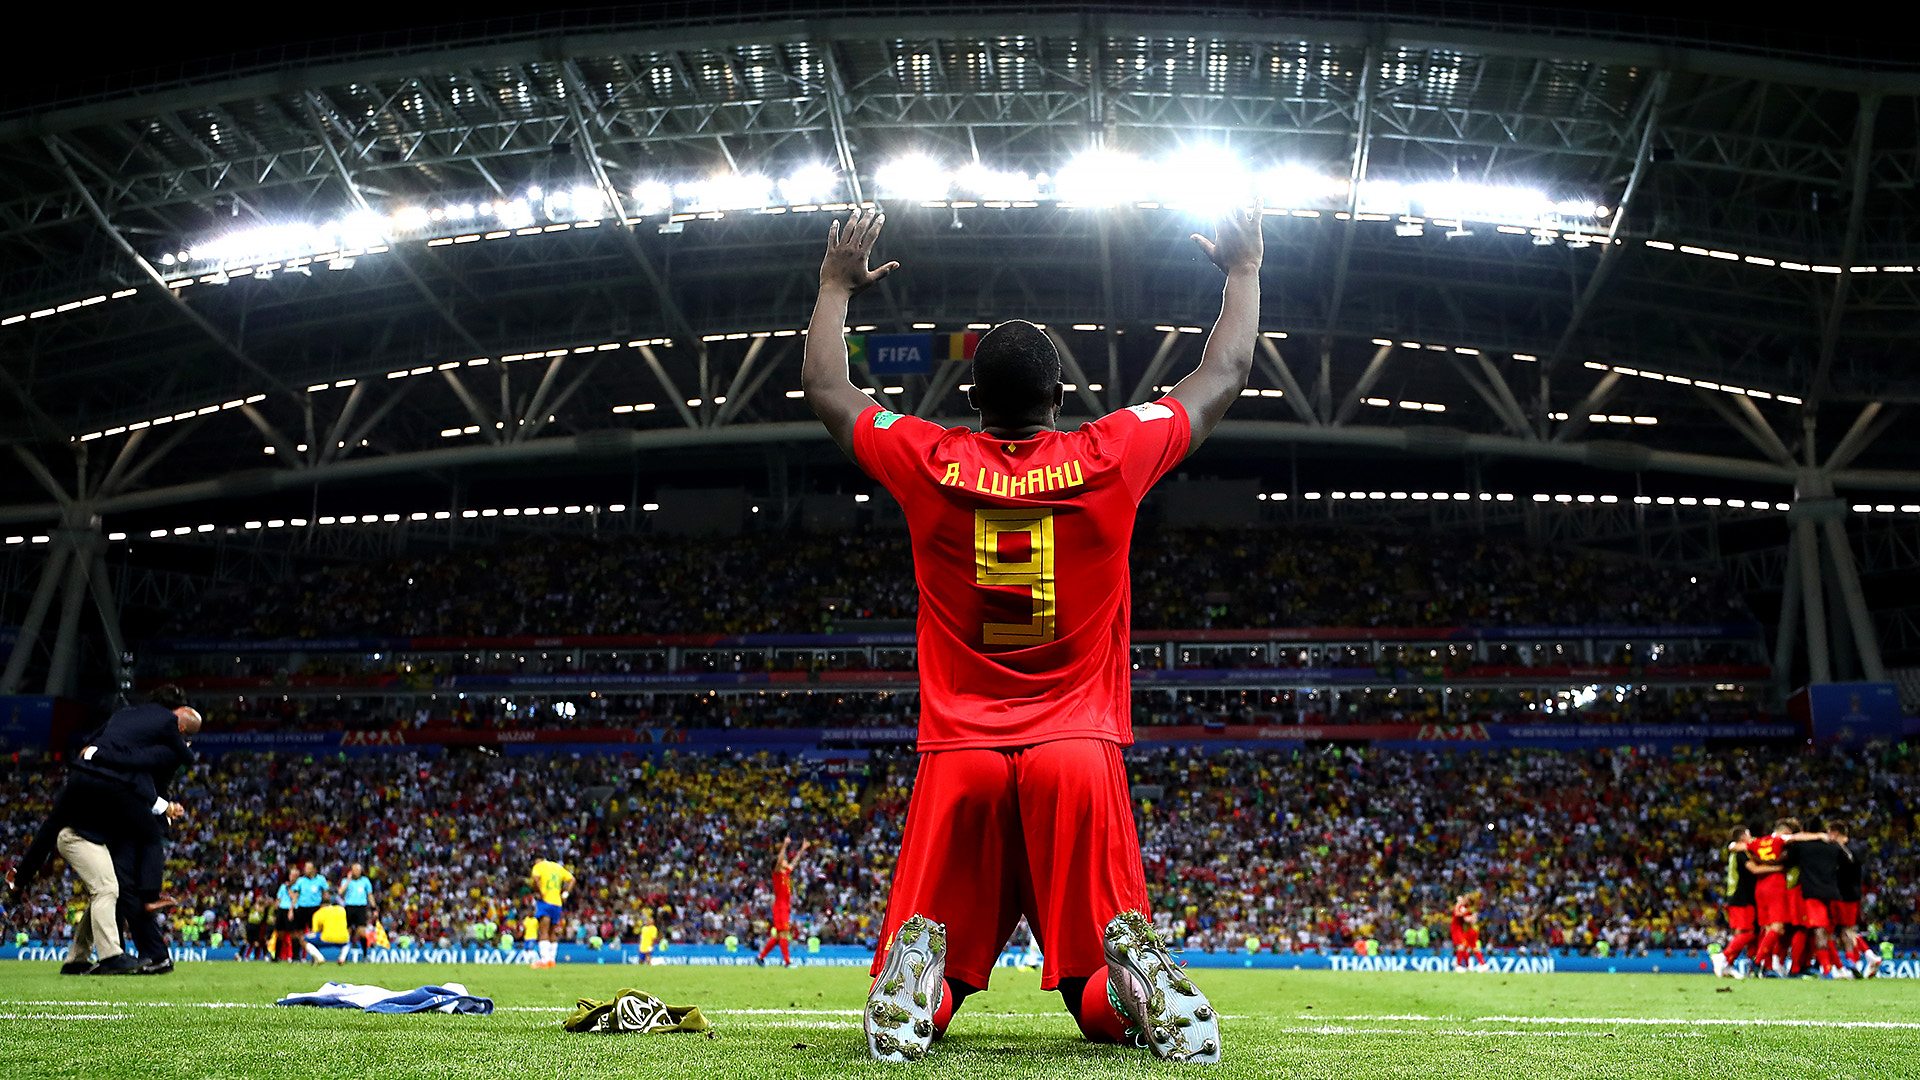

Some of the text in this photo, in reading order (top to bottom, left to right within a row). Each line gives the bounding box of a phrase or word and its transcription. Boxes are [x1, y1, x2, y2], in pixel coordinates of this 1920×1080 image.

[878, 346, 921, 362] FIFA
[940, 459, 1084, 498] R. LUKAKU
[975, 508, 1056, 645] 9
[423, 949, 467, 964] YOU
[1328, 955, 1408, 971] THANK
